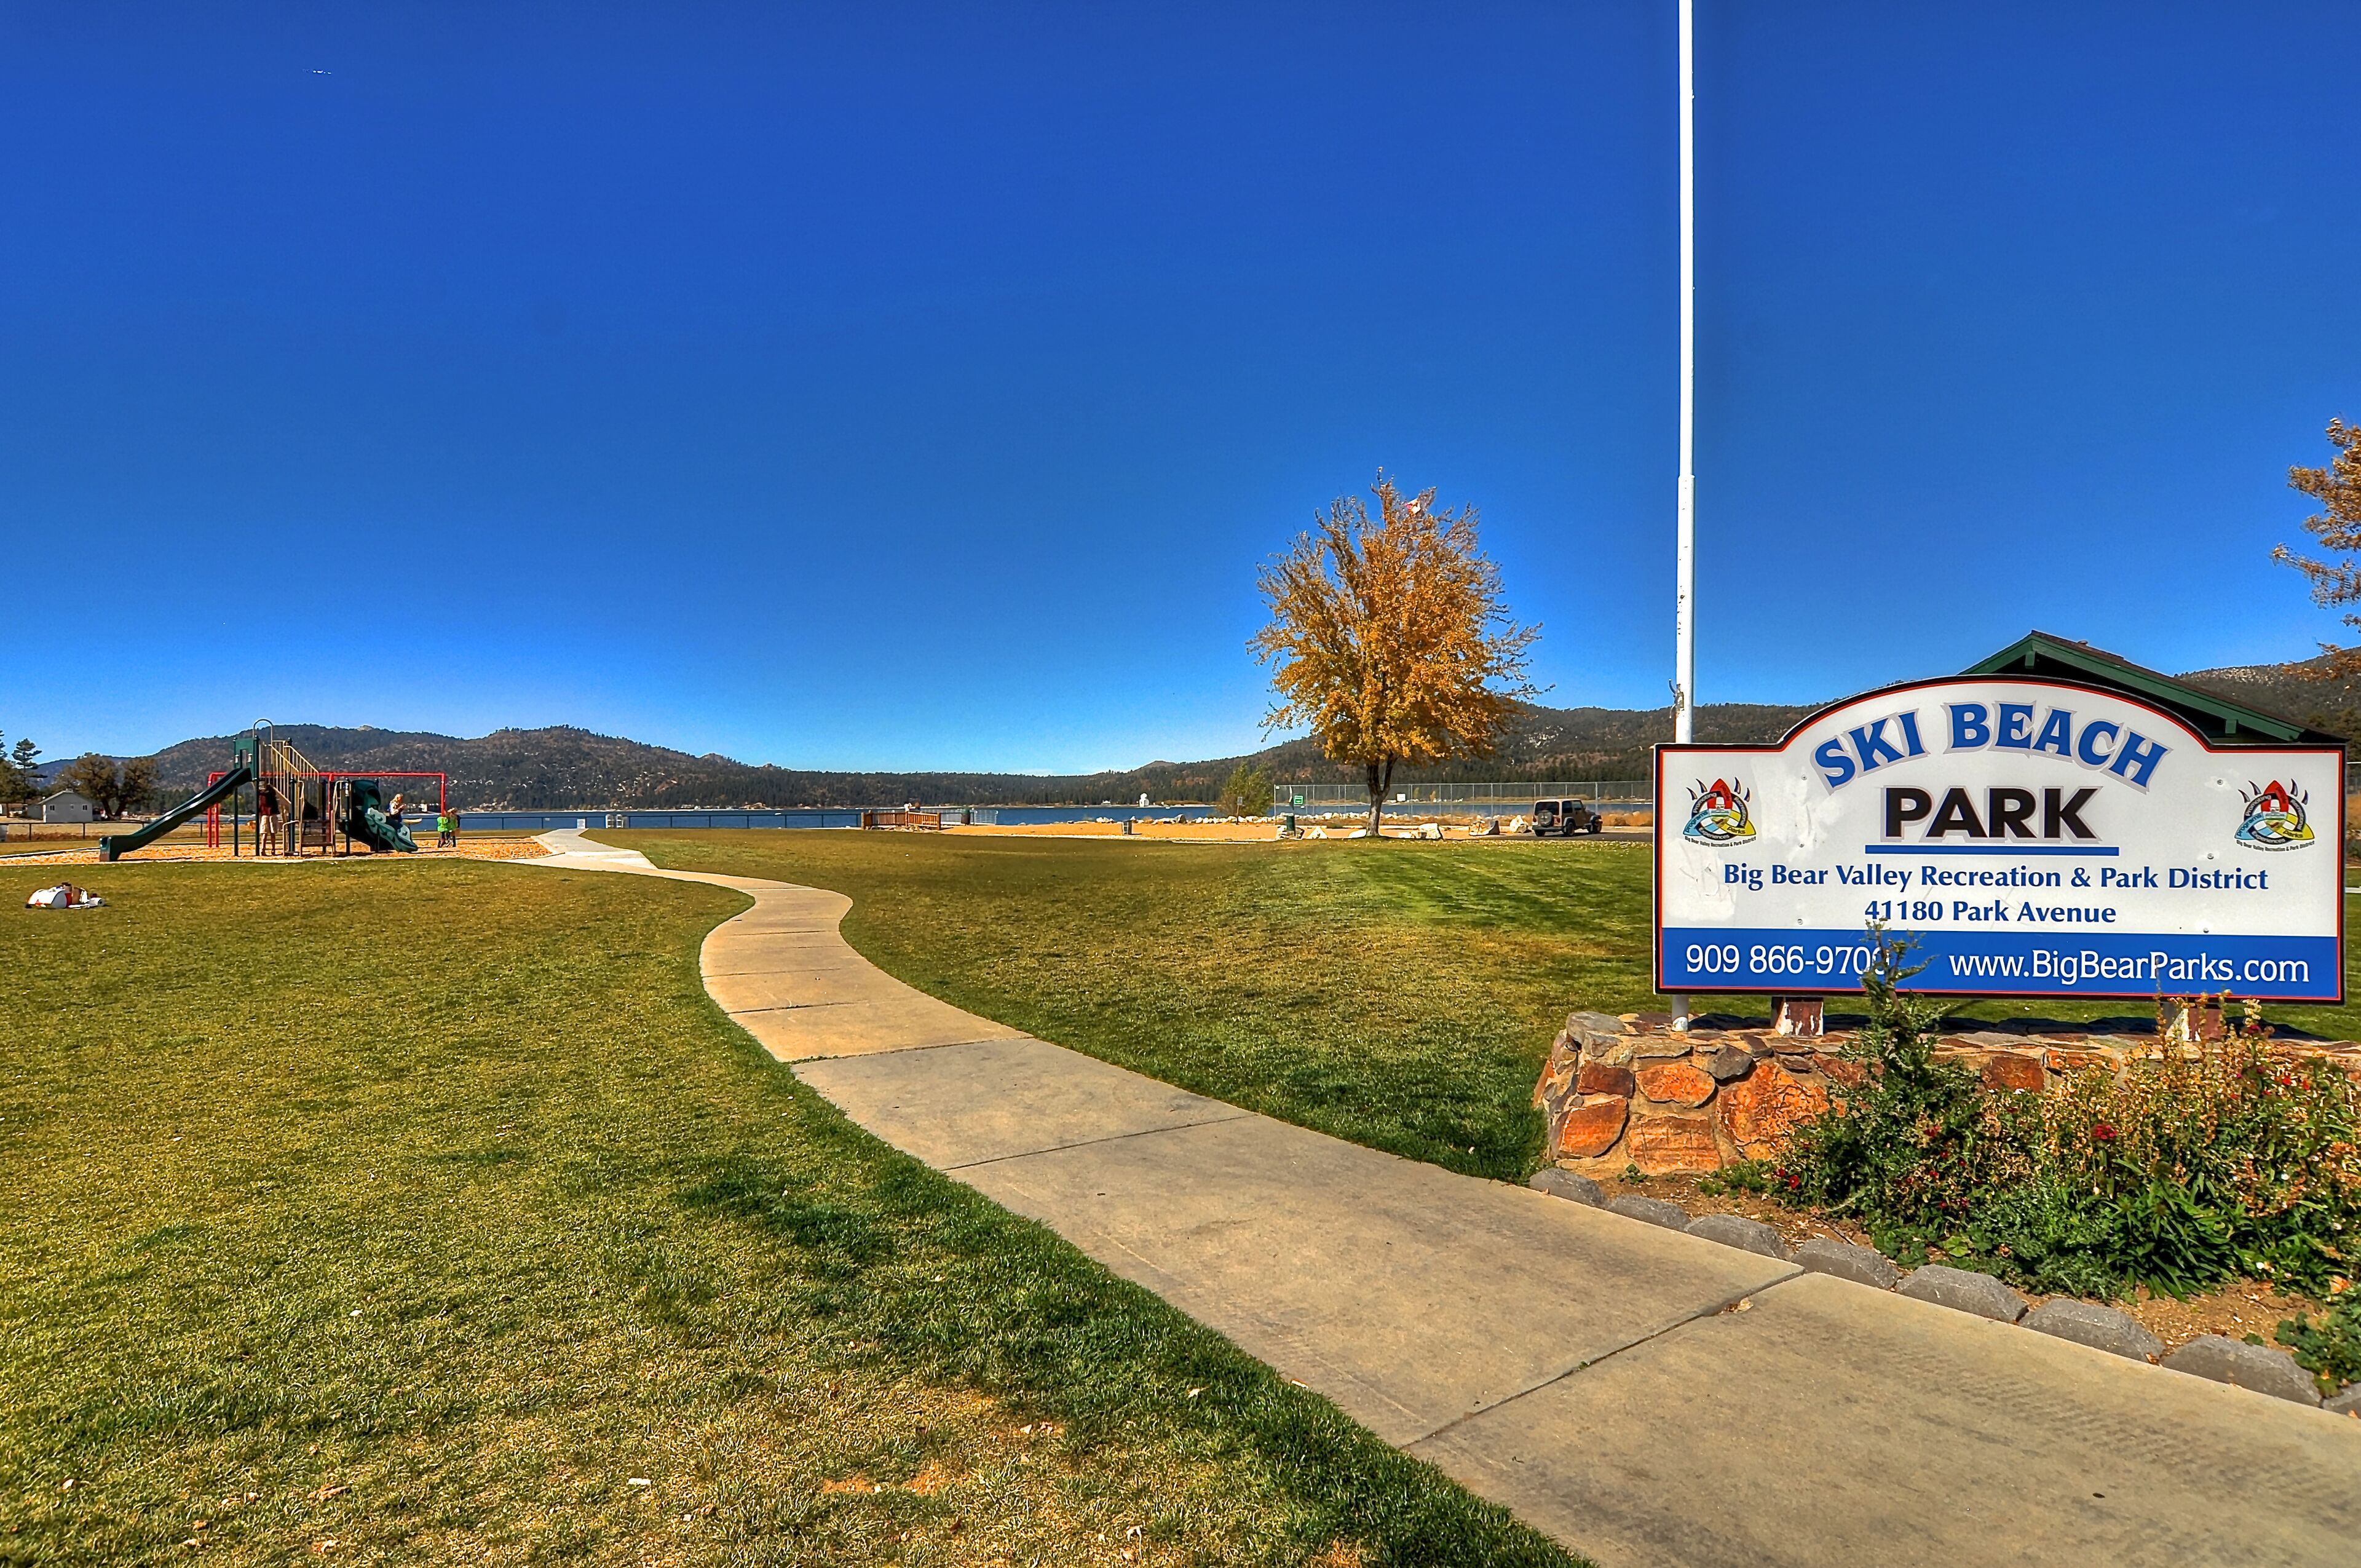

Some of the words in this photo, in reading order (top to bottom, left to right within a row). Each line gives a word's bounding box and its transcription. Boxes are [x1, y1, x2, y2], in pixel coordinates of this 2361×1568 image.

[1813, 708, 1926, 789] SKI
[1948, 703, 2168, 788] BEACH
[1693, 793, 1717, 813] Promoting
[1885, 787, 2098, 839] PARK
[2245, 794, 2271, 816] Promoting
[1725, 863, 1763, 891] Big
[1772, 865, 1829, 885] Bear
[1835, 863, 1913, 893] Valley
[1921, 865, 2061, 887] Recreation
[2071, 867, 2091, 887] &
[2101, 866, 2159, 888] Park
[2169, 866, 2269, 890] District
[1865, 900, 1943, 921] 41180
[1953, 900, 2009, 921] Park
[2017, 901, 2116, 923] Avenue
[1686, 944, 1739, 973] 909
[1948, 949, 2310, 985] www.BigBearParks.com
